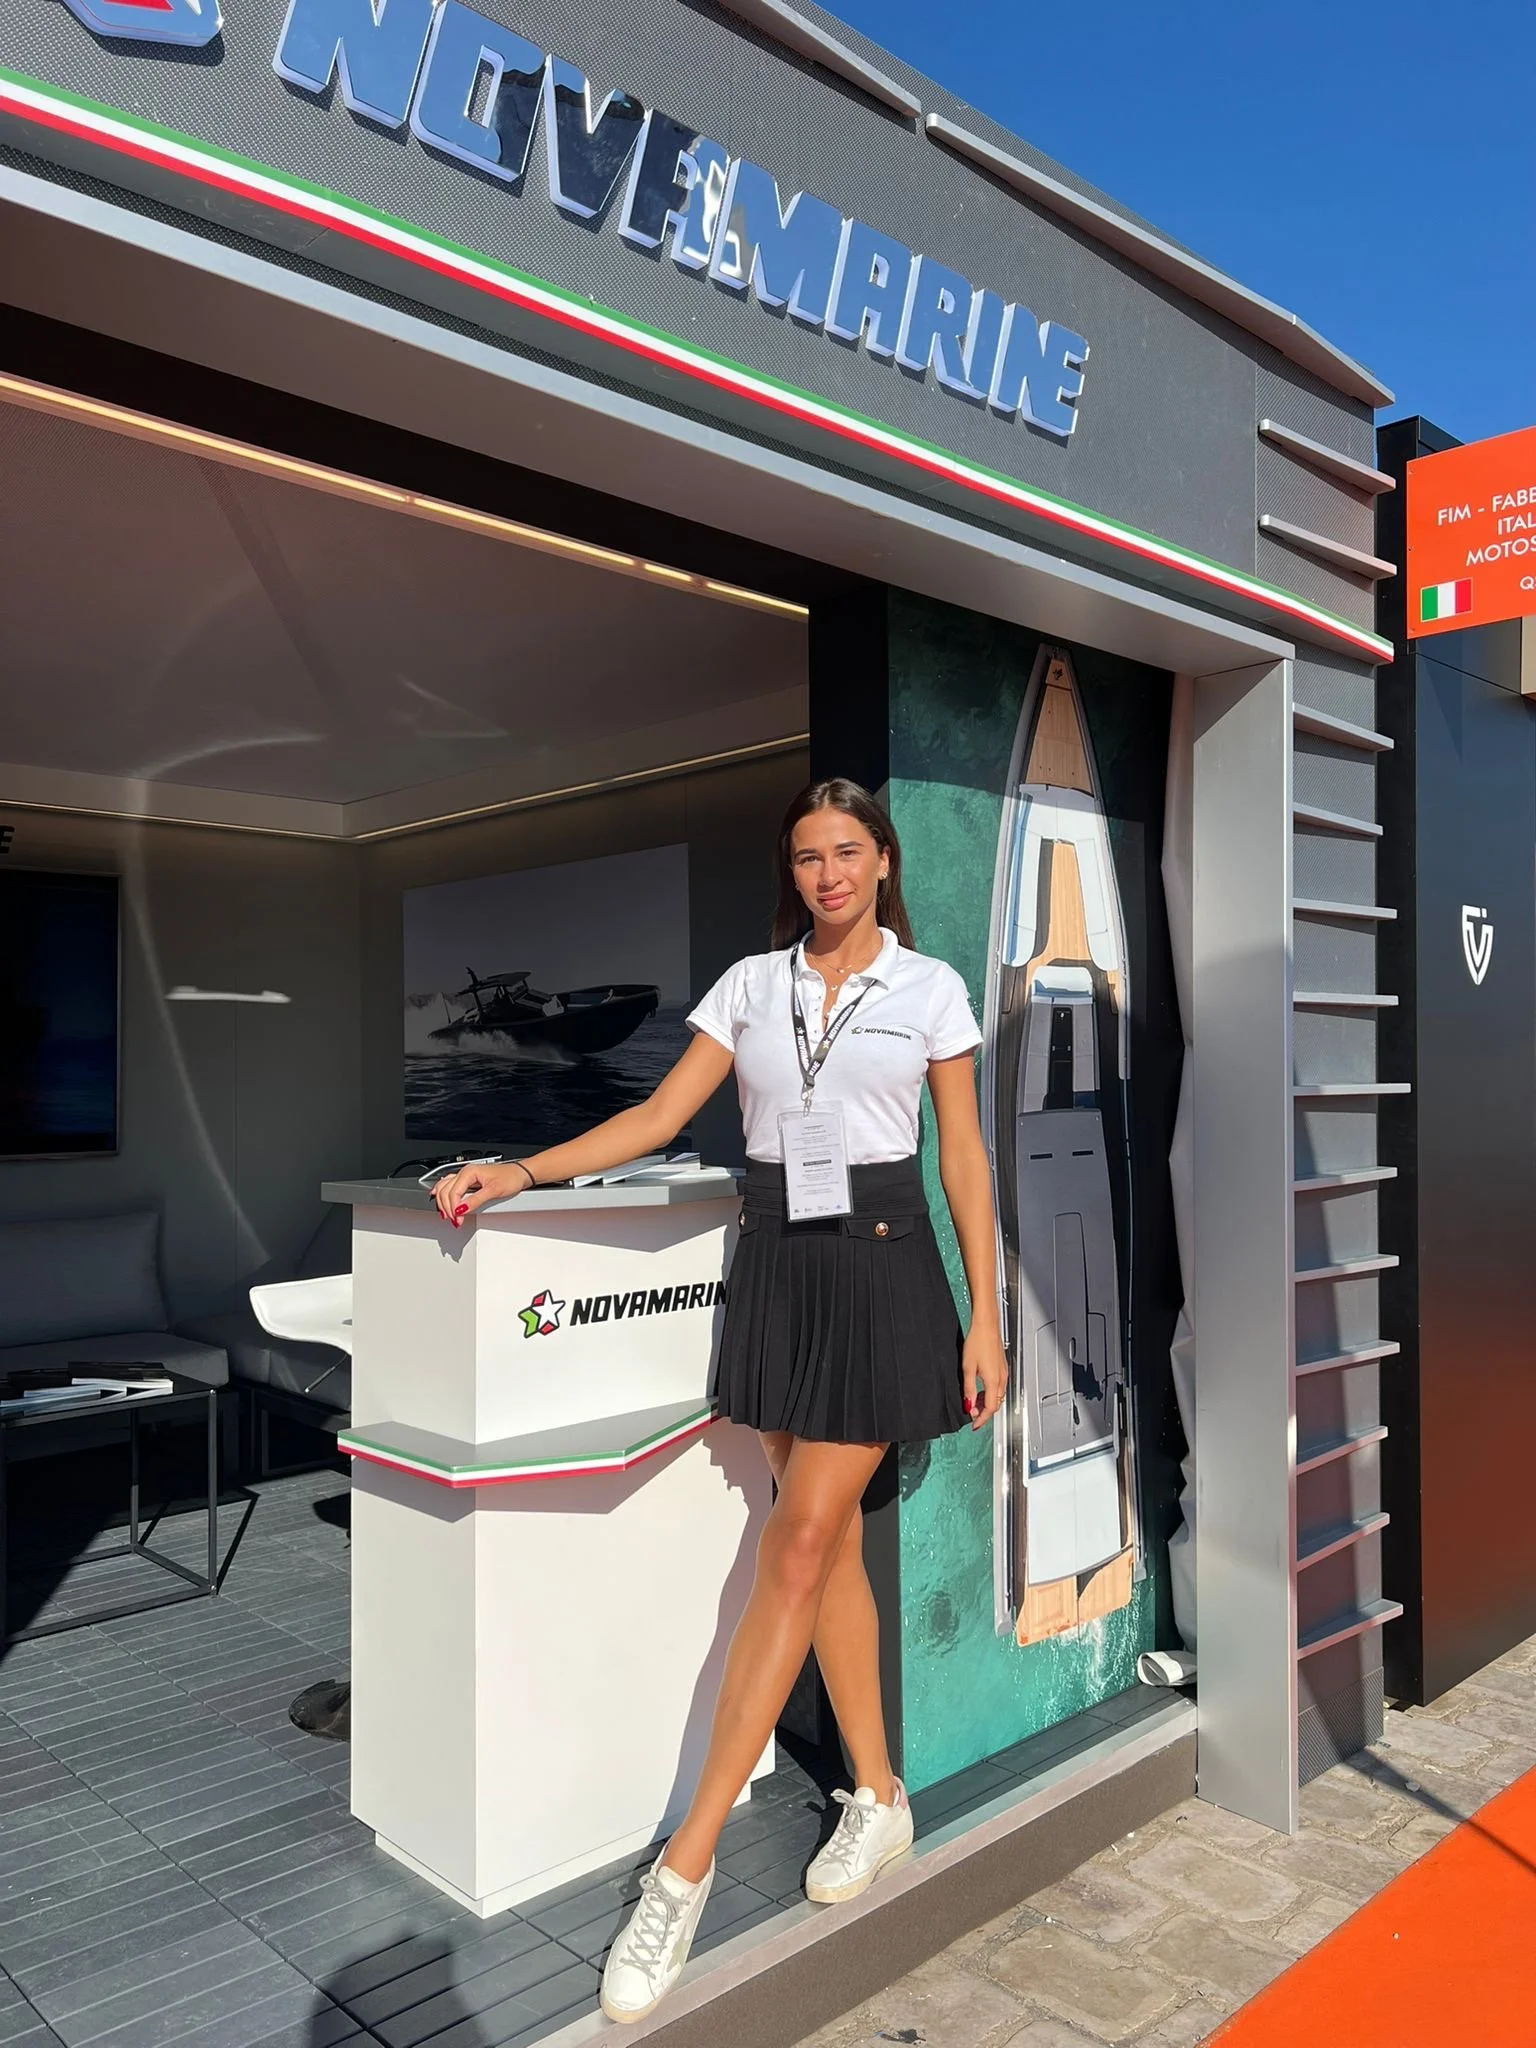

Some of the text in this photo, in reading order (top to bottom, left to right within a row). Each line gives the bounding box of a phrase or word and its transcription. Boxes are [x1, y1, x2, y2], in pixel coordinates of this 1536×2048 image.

[272, 0, 1090, 437] NOVAMARINE
[1437, 504, 1471, 526] FIM
[1497, 511, 1536, 536] ITAL
[1519, 575, 1536, 590] Q
[569, 1280, 728, 1326] NOVAMARIN
